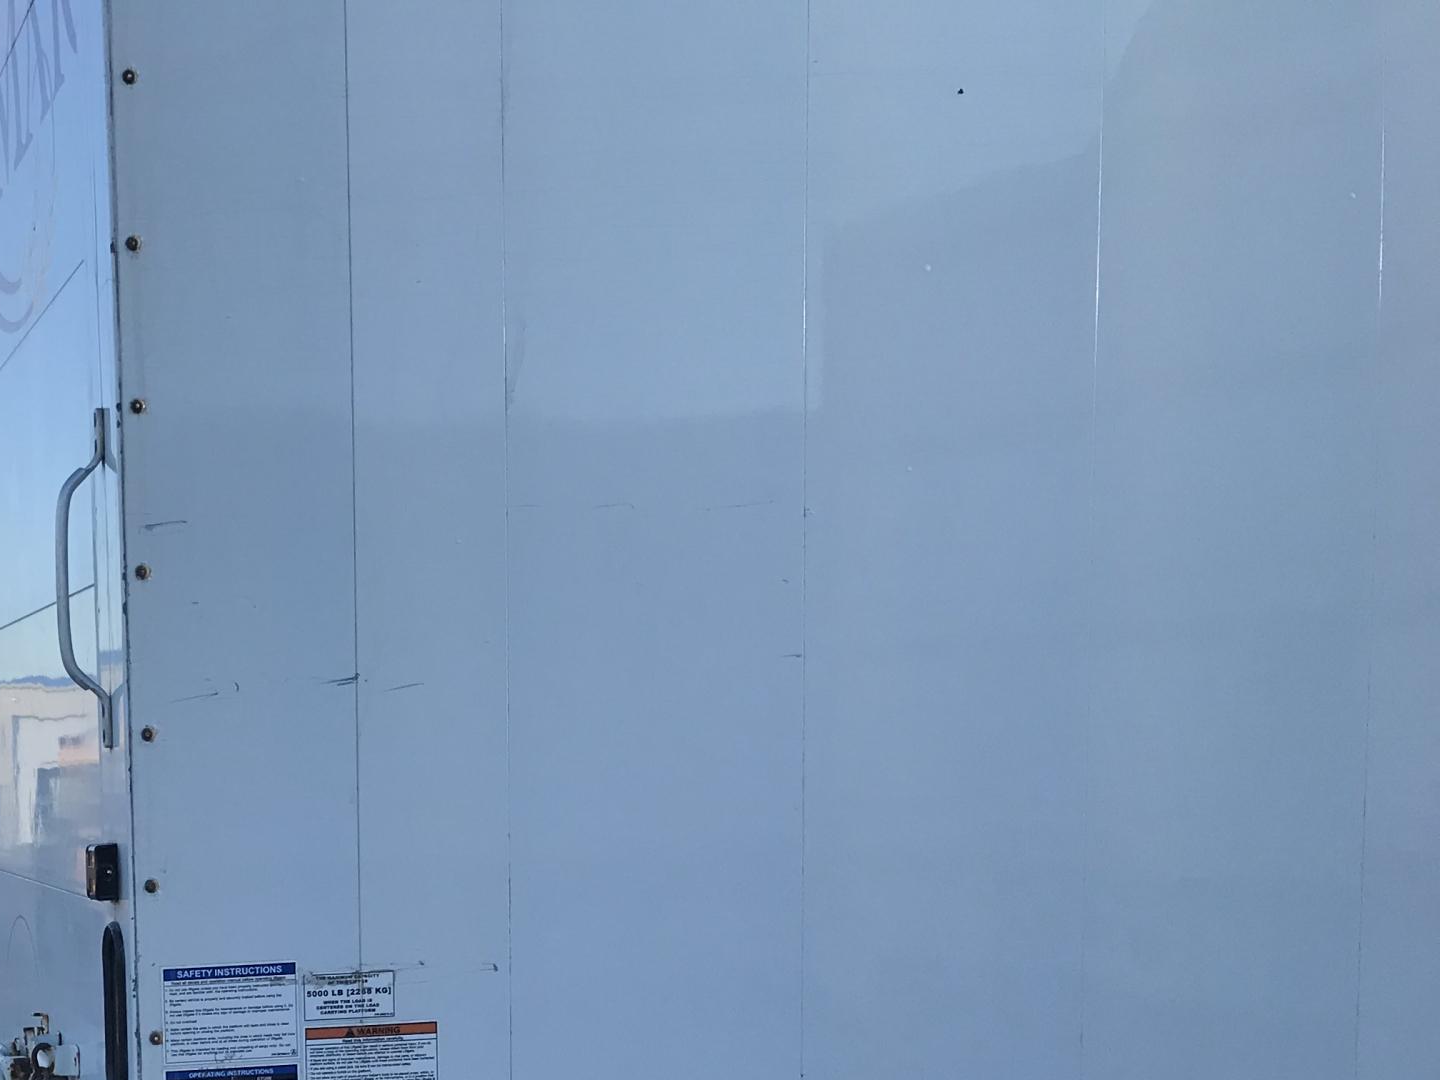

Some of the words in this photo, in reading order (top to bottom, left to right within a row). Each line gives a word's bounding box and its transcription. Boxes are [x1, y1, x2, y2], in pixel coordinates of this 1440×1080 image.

[177, 969, 213, 979] SAFETY
[214, 965, 282, 976] INSTRUCTIONS
[357, 1026, 401, 1036] WARNING
[227, 1068, 274, 1076] INSTRUCTIONS
